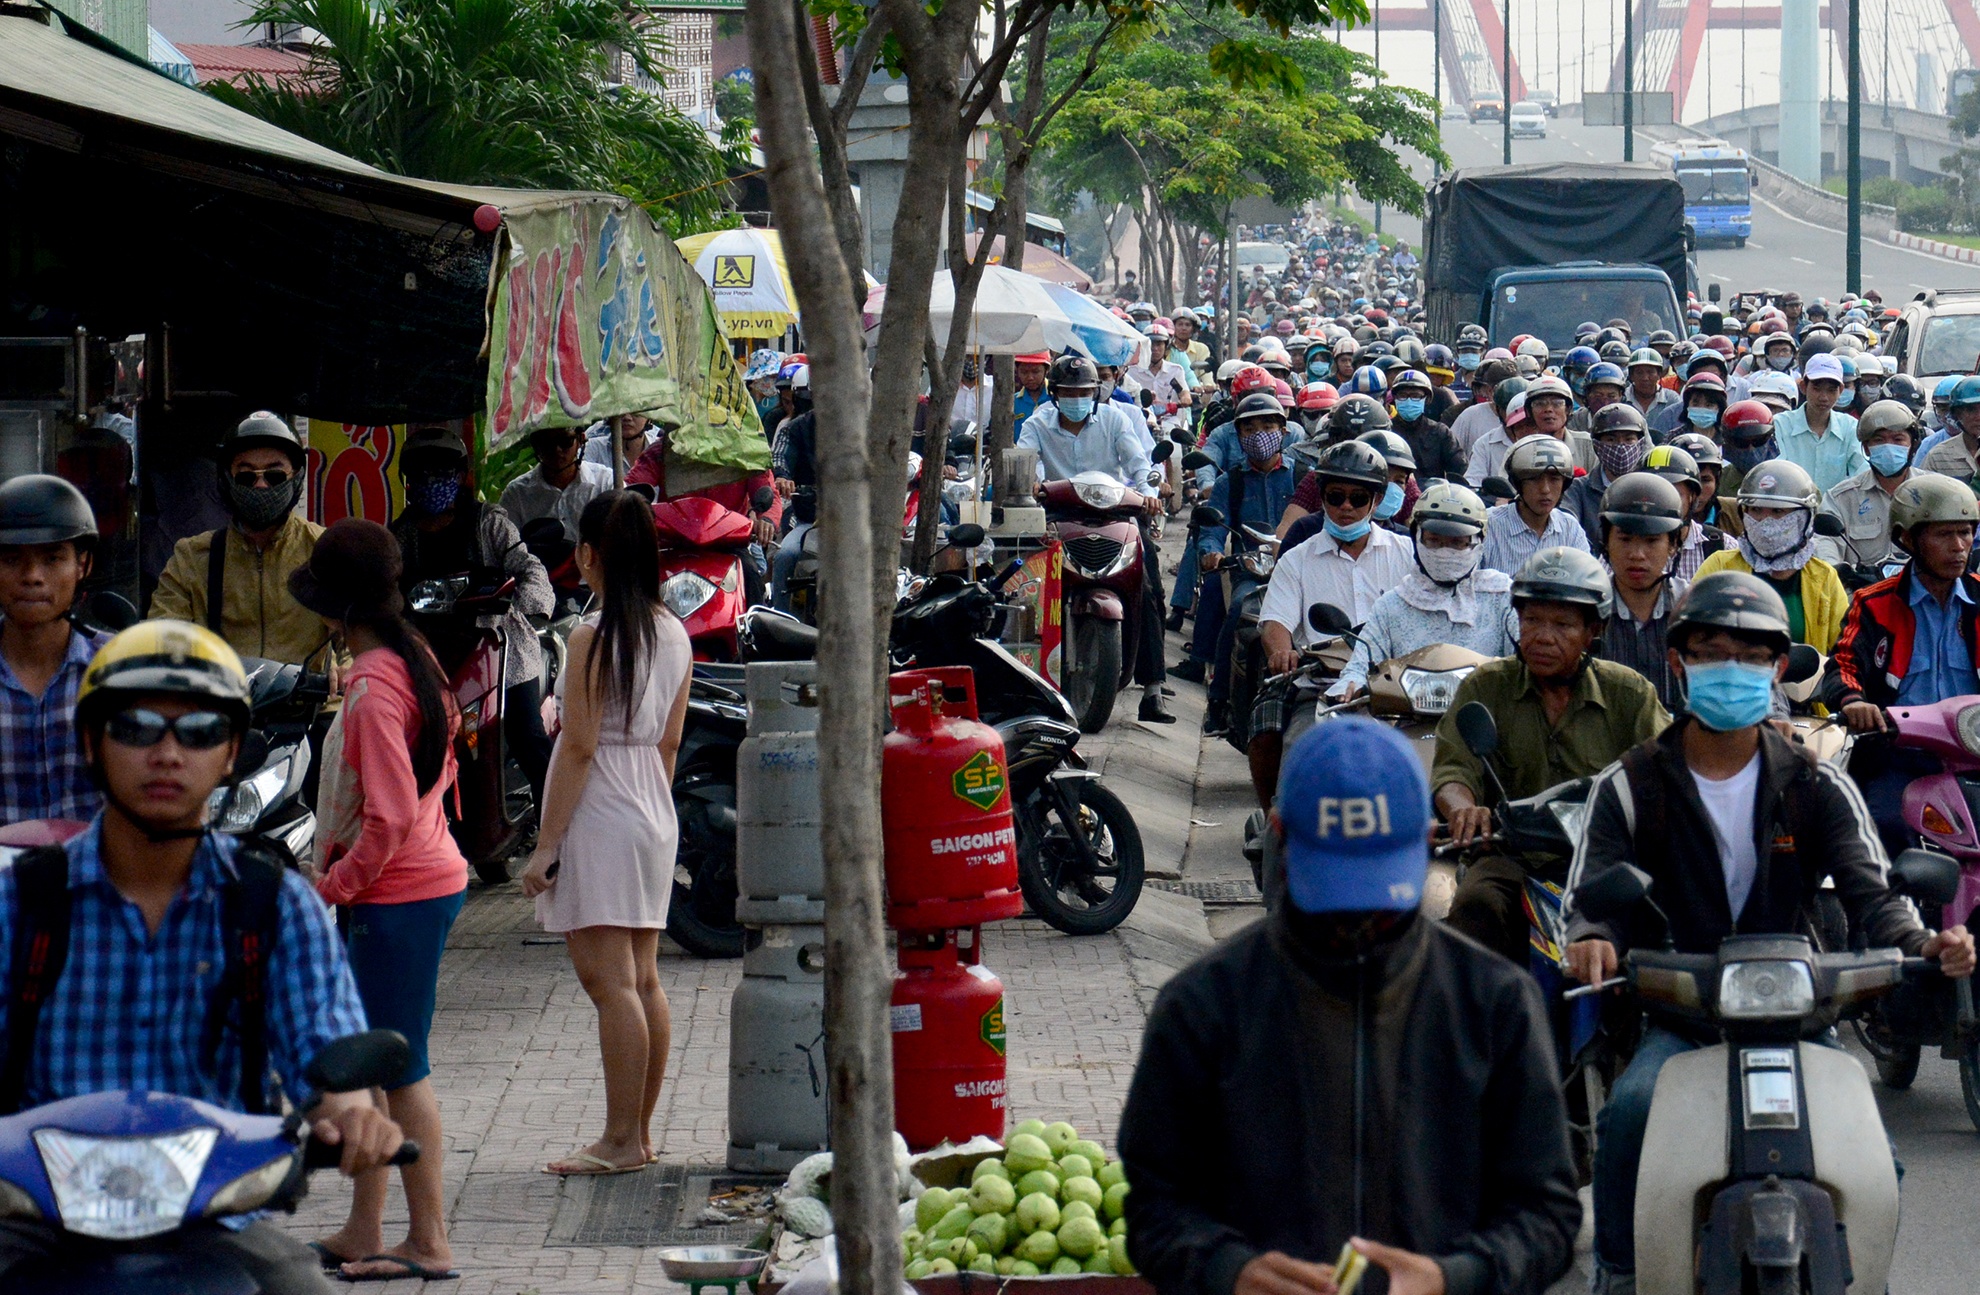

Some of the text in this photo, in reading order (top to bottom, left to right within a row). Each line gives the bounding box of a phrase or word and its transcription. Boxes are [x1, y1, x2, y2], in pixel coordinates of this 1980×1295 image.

[724, 319, 773, 331] .yp.vn
[1040, 735, 1067, 745] HONDA
[963, 765, 999, 788] SP
[1317, 793, 1391, 838] FBI
[930, 832, 994, 855] SAIGON
